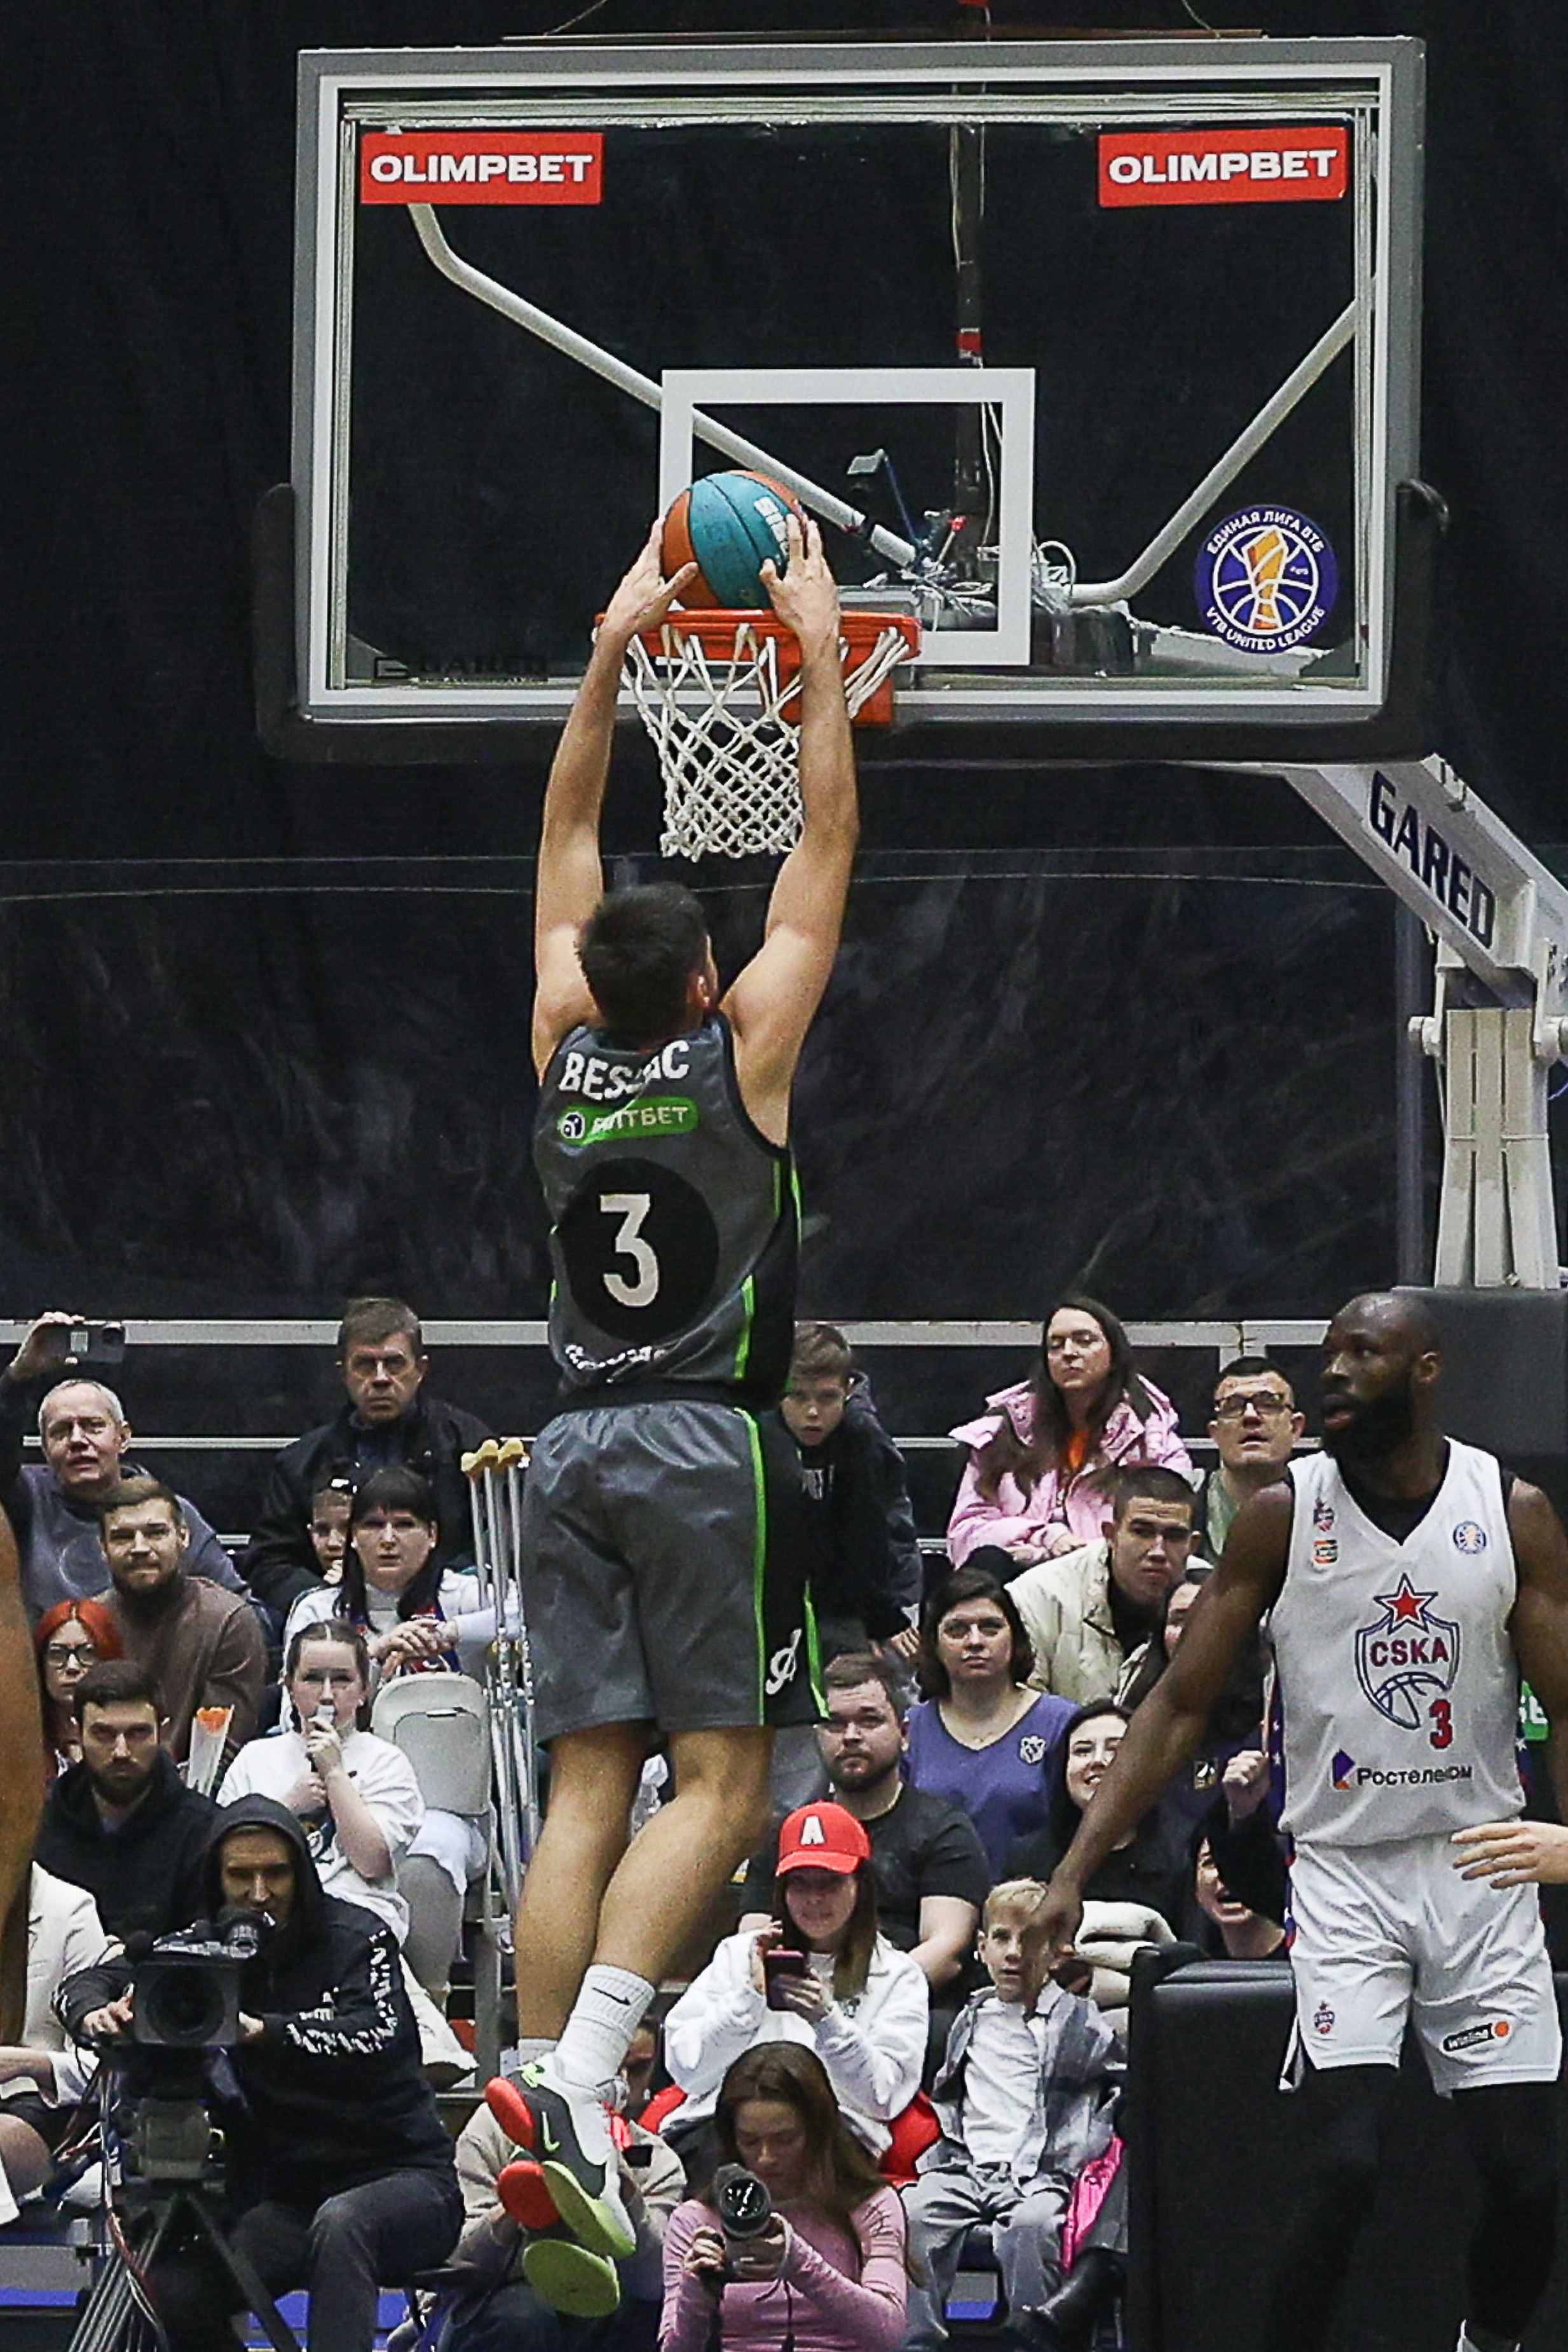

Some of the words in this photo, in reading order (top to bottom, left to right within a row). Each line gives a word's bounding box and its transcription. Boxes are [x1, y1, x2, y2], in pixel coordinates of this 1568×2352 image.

[371, 154, 593, 182] OLIMPBET
[1109, 149, 1337, 184] OLIMPBET
[1207, 511, 1260, 554] ЕДИНАЯ
[1263, 511, 1300, 532] ЛИГА
[1300, 526, 1325, 553] ВТБ
[1206, 606, 1228, 634] VTB
[1227, 629, 1276, 650] UNITED
[1278, 605, 1326, 647] LEAGUE
[1370, 757, 1496, 950] GARED
[599, 1193, 658, 1307] 3
[1370, 1636, 1450, 1667] CSKA
[1428, 1698, 1453, 1750] 3
[800, 1815, 826, 1845] A
